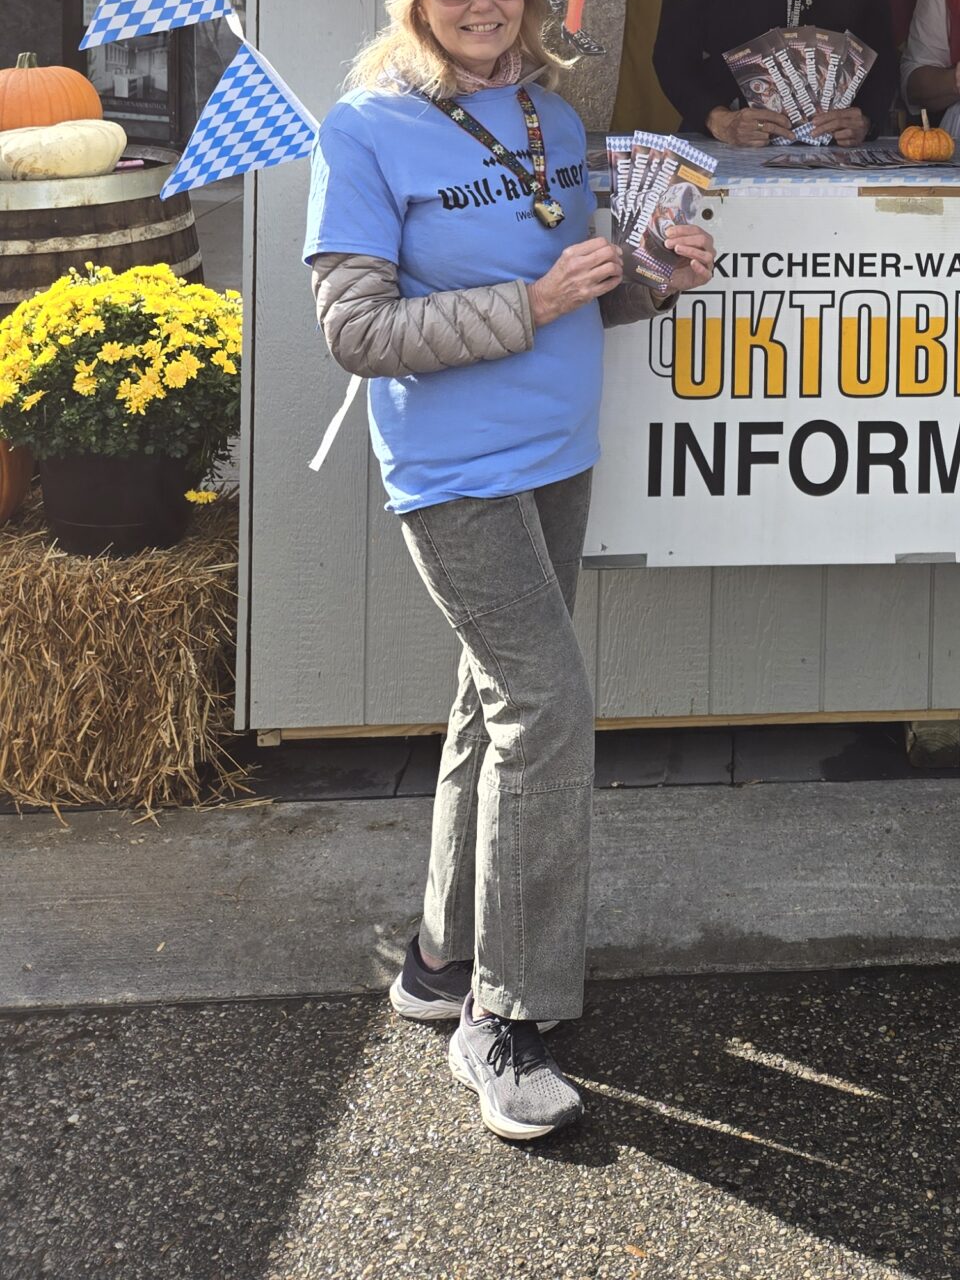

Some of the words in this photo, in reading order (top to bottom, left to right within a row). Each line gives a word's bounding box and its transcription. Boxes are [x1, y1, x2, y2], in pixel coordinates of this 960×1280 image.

[762, 55, 802, 124] Willkommen!
[775, 48, 817, 118] Willkommen!
[625, 157, 679, 248] Willkommen!
